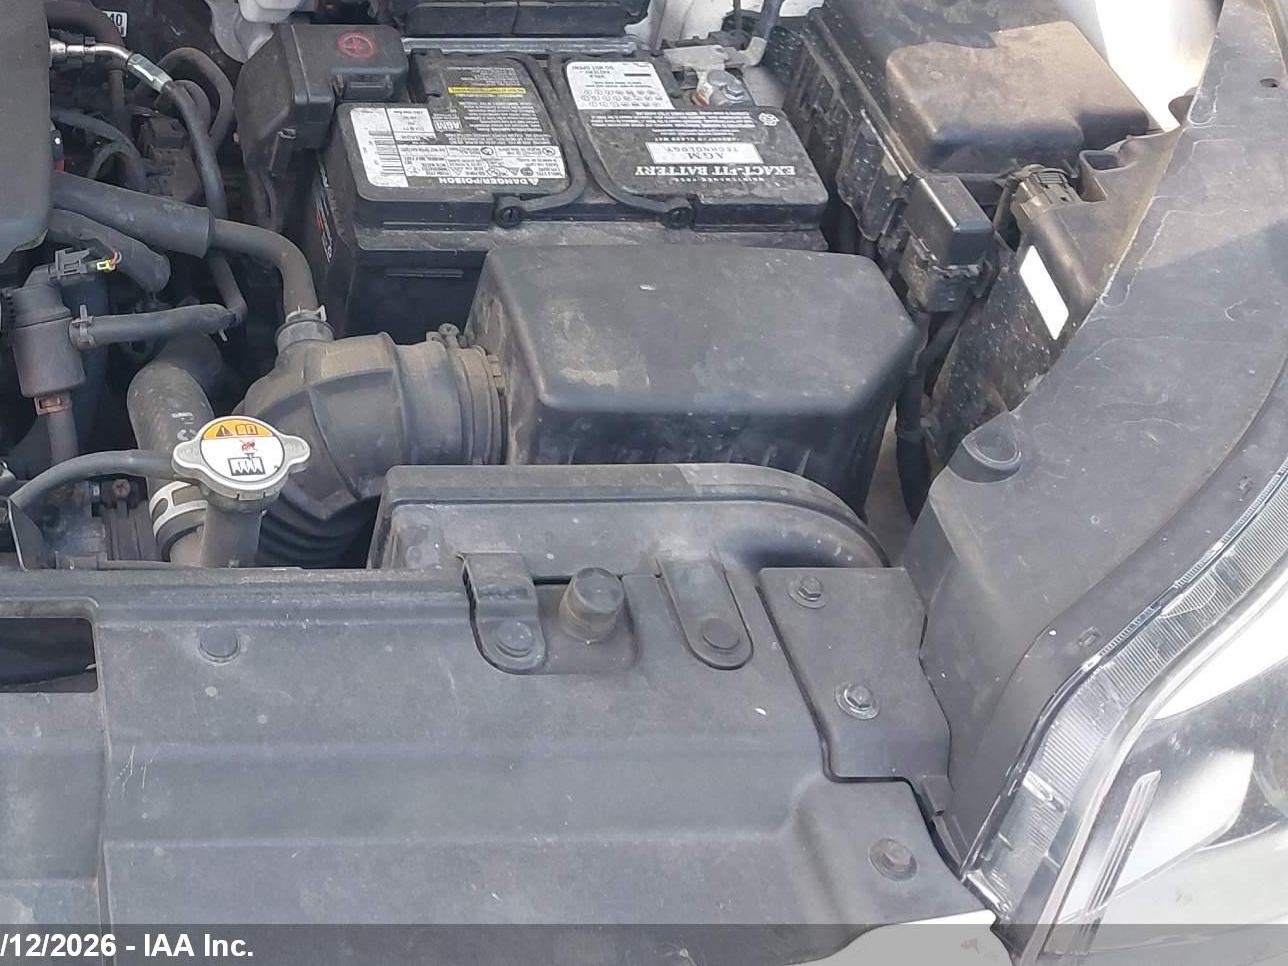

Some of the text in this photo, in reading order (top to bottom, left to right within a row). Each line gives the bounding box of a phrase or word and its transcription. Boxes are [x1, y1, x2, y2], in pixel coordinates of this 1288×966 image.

[435, 121, 460, 131] AGM
[686, 152, 725, 160] AGM
[634, 165, 796, 176] EXACT-FIT BATTERY
[438, 177, 529, 186] DANGER/POISON
